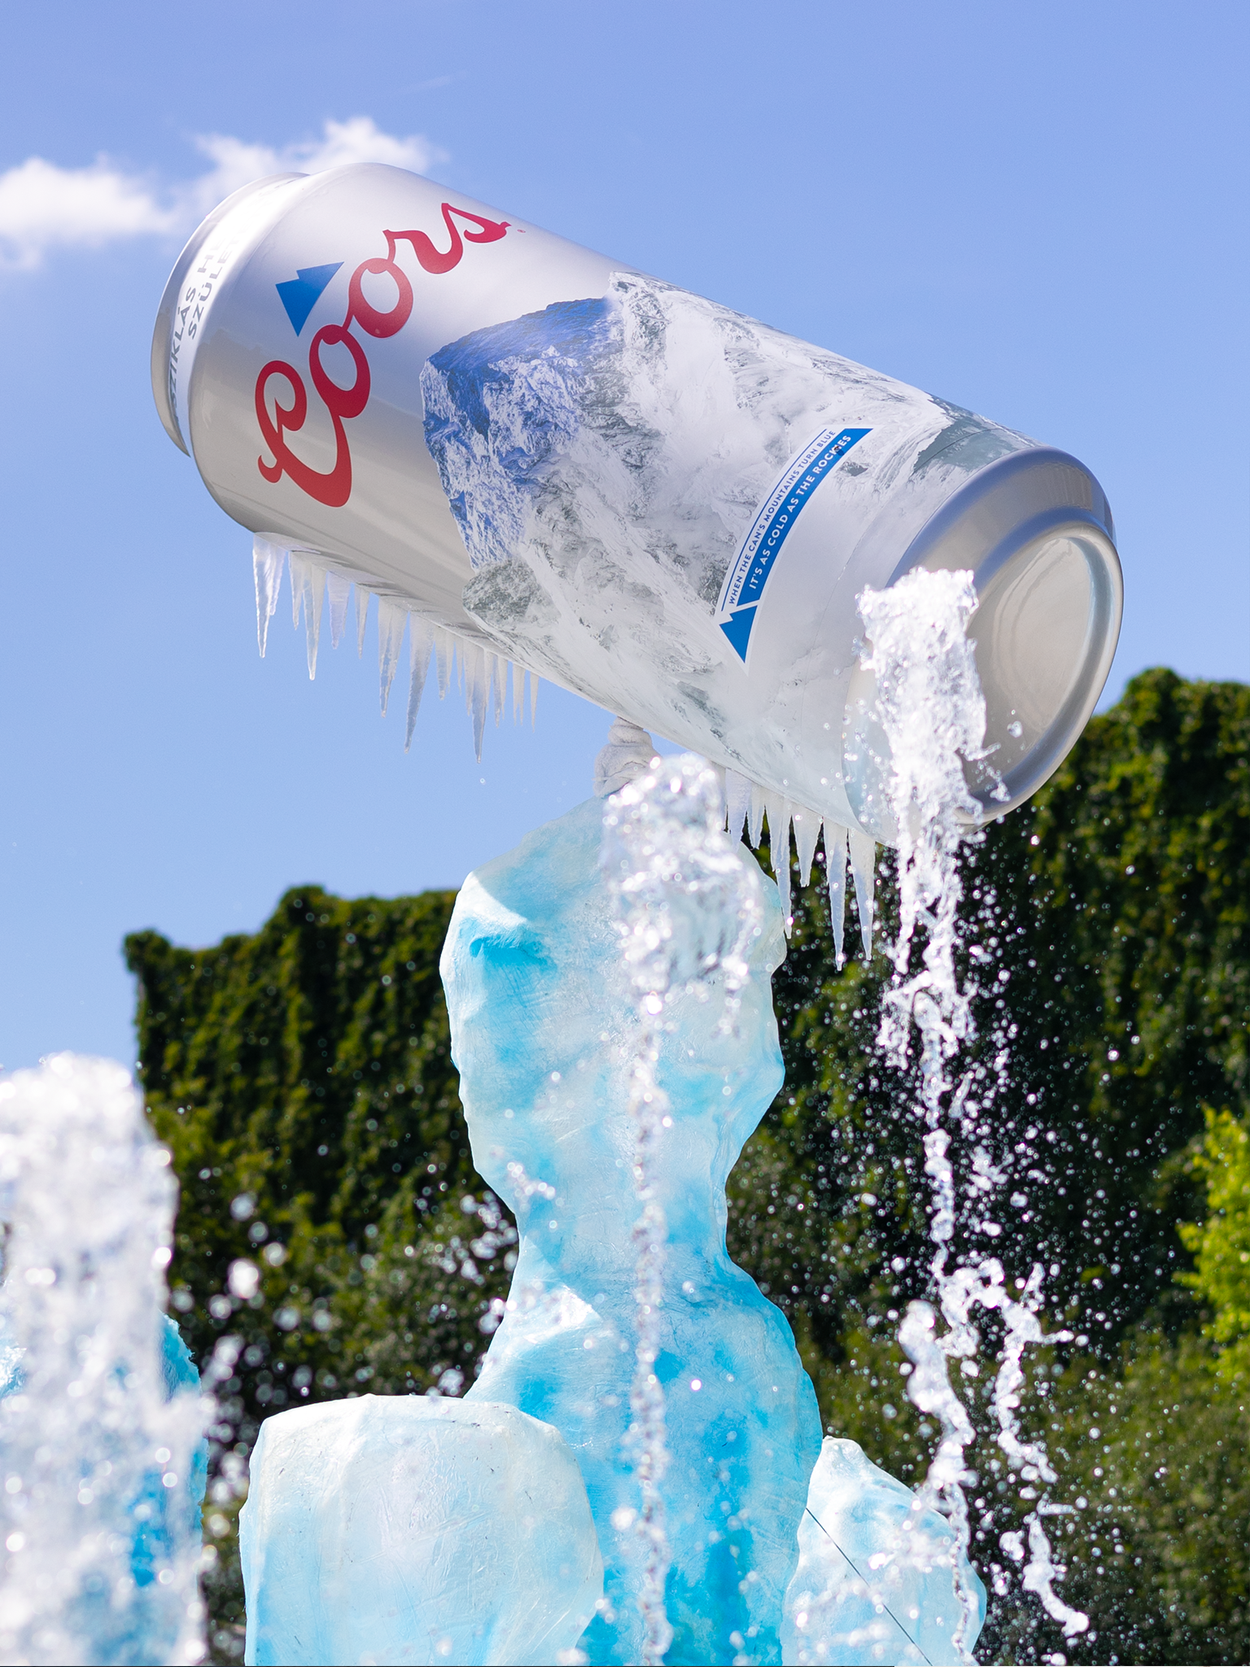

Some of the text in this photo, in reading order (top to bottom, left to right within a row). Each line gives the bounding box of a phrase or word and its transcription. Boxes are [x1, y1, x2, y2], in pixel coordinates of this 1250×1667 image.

[254, 202, 512, 508] Coors
[729, 430, 836, 604] WHEN THE CAN'S MOUNTAINS TURN BLUE
[749, 567, 763, 589] IT'S
[759, 550, 771, 566] AS
[767, 514, 789, 547] COLD
[787, 497, 799, 513] AS
[796, 475, 815, 496] THE
